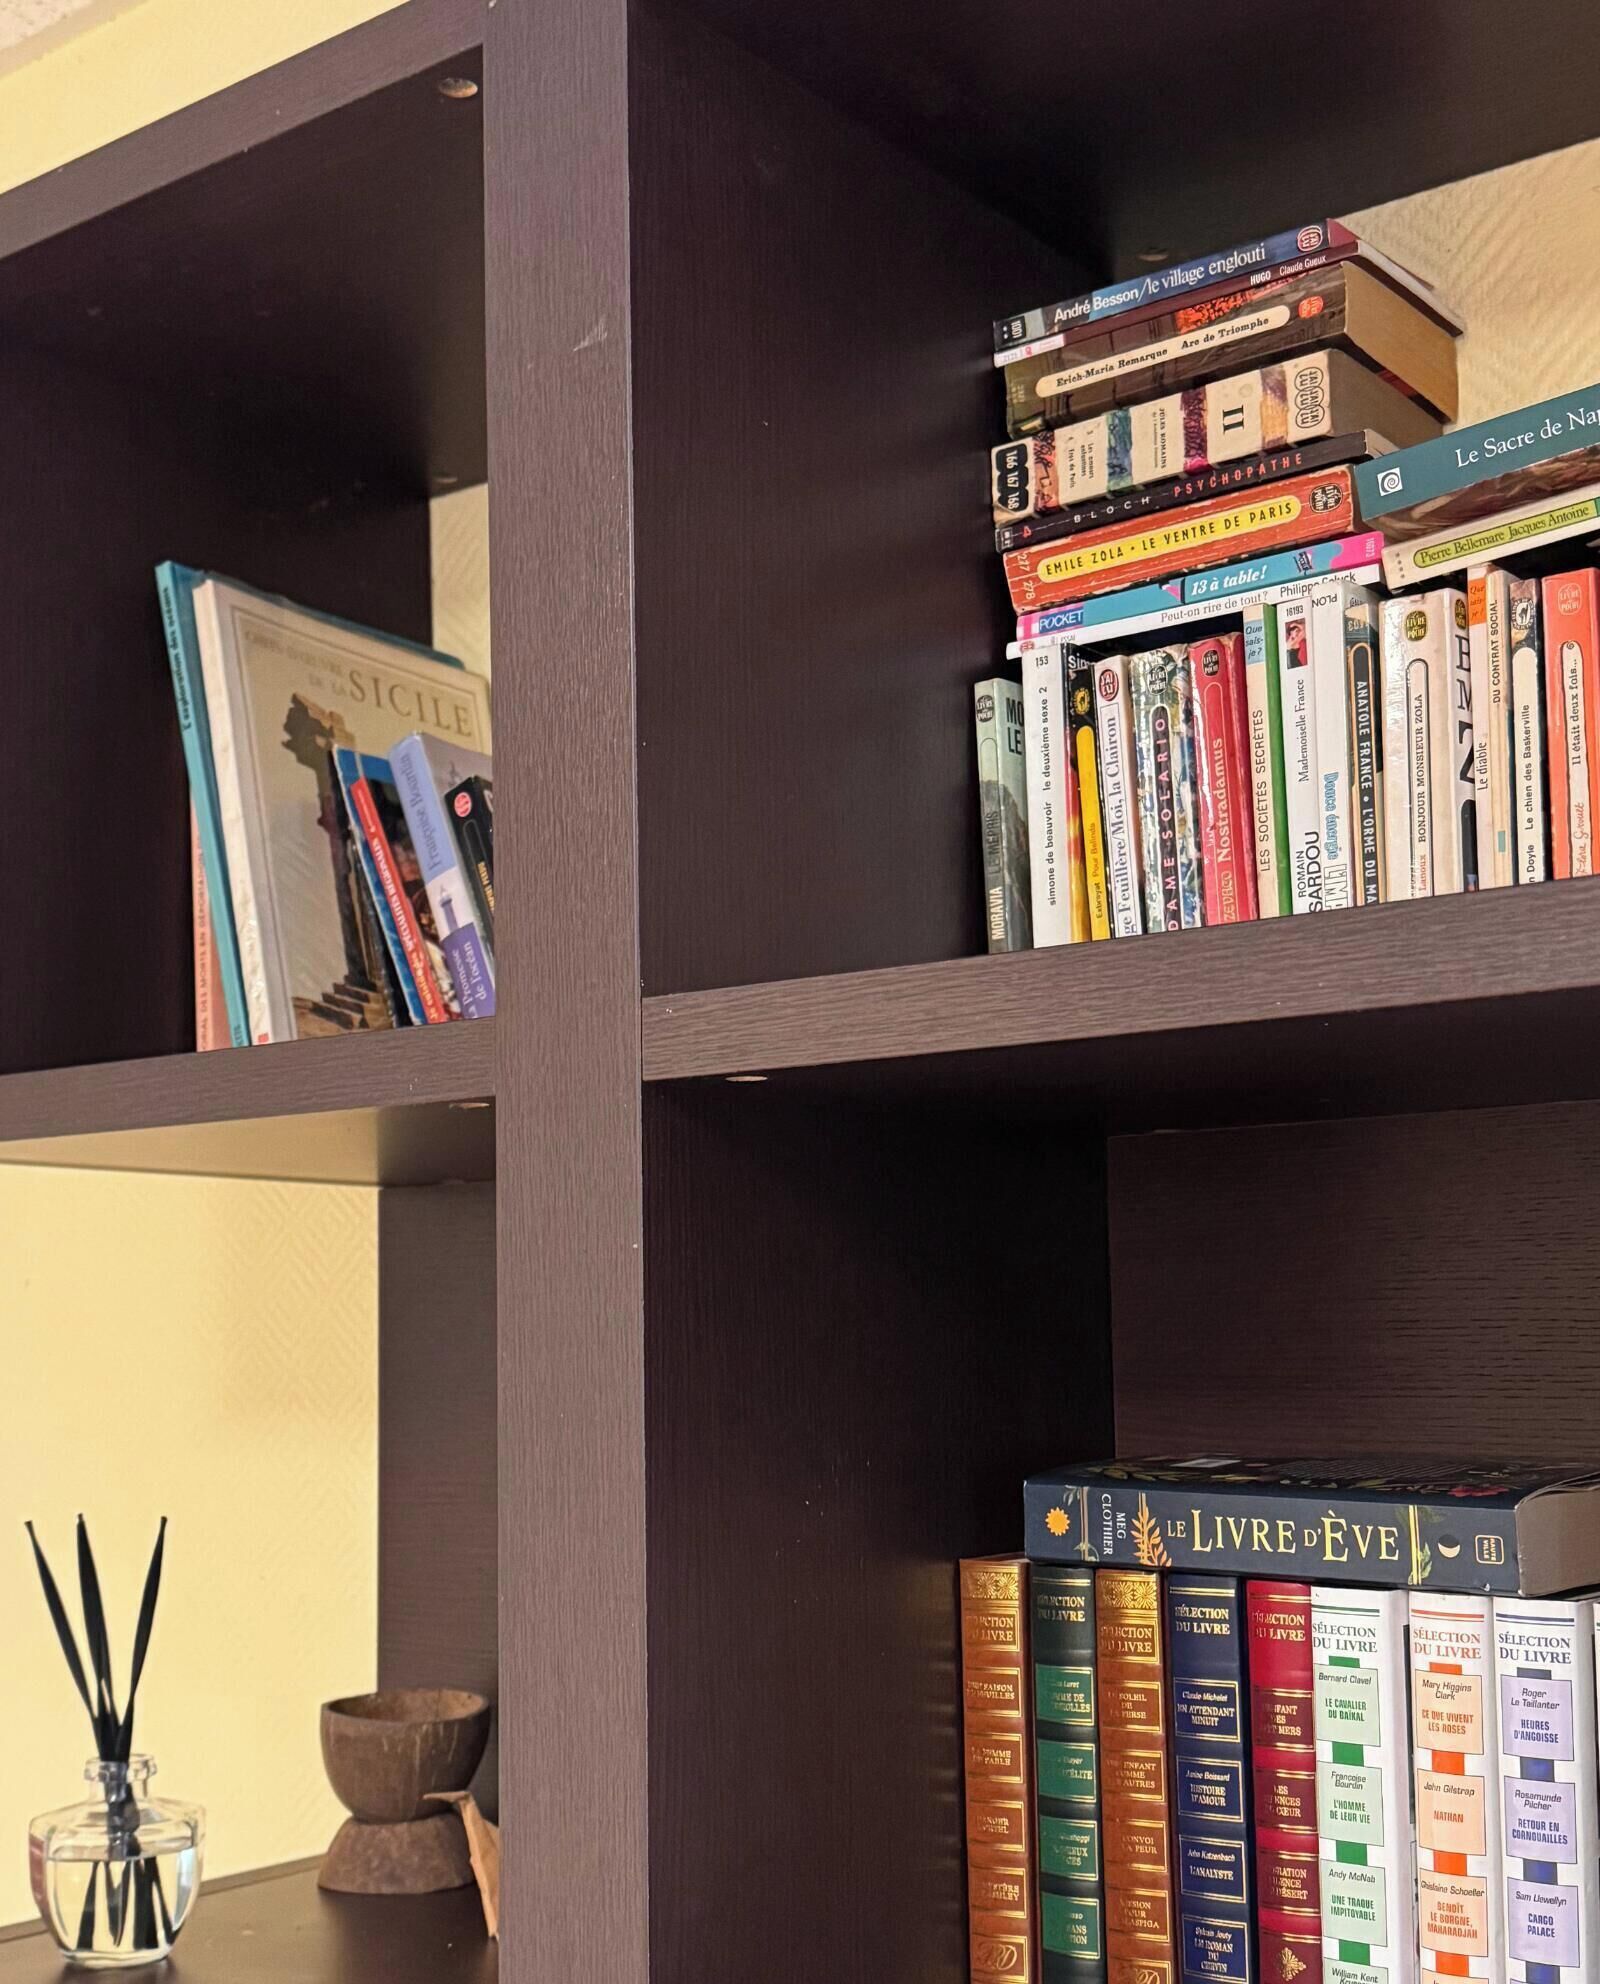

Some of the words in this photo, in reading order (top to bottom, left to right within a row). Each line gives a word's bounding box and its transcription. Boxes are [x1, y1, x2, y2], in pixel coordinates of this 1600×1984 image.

[1250, 270, 1271, 287] HUGO
[1279, 261, 1303, 276] Claude
[1304, 254, 1327, 269] Gueux
[1053, 299, 1091, 324] André
[1160, 264, 1206, 292] village
[1208, 243, 1266, 276] englouti
[1056, 362, 1116, 388] Erich-Maria
[1117, 347, 1168, 370] Remarque
[1180, 337, 1200, 351] Arc
[1202, 333, 1215, 346] de
[1217, 316, 1270, 340] Triomphe
[1455, 448, 1480, 468] Le
[1483, 431, 1535, 458] Sacre
[1540, 419, 1563, 440] de
[1006, 450, 1018, 470] 166
[1007, 472, 1019, 488] 167
[1173, 453, 1302, 498] PSYCHOPATHE
[1046, 557, 1084, 576] EMILE
[1091, 546, 1124, 564] ZOLA
[1142, 537, 1157, 551] LE
[1163, 519, 1215, 545] VENTRE
[1224, 512, 1240, 530] DE
[1250, 502, 1292, 524] PARIS
[1419, 547, 1452, 565] Pierre
[1453, 531, 1505, 554] Bellemare
[1508, 519, 1547, 541] Jacques
[1548, 505, 1590, 527] Antoine
[1039, 609, 1084, 631] POCKET
[1191, 580, 1207, 596] 13
[1209, 576, 1219, 591] à
[1222, 565, 1268, 589] table!
[1311, 594, 1338, 608] PLON
[1160, 606, 1201, 624] Peut-on
[1203, 602, 1222, 616] rire
[1224, 596, 1238, 610] de
[1240, 593, 1262, 607] tout
[1490, 599, 1499, 636] SOCIAL
[1245, 625, 1263, 635] Que
[1035, 655, 1049, 667] 153
[1491, 639, 1500, 686] CONTRAT
[349, 669, 472, 737] SICILE
[1294, 679, 1305, 713] France
[1492, 689, 1501, 704] DU
[1041, 698, 1049, 724] sexe
[1355, 681, 1372, 741] ANATOLE
[1414, 694, 1423, 724] ZOLA
[1570, 694, 1580, 722] deux
[1521, 704, 1532, 759] Baskerville
[1571, 726, 1581, 752] était
[1105, 716, 1120, 778] Clairon
[1252, 708, 1266, 776] SECRÈTES
[1296, 714, 1309, 783] Mademoiselle
[1042, 727, 1052, 778] deuxième
[1415, 727, 1425, 787] MONSIEUR
[1475, 742, 1488, 775] diable
[1358, 741, 1373, 790] FRANCE
[1523, 763, 1532, 781] des
[1042, 781, 1052, 791] le
[1108, 781, 1122, 797] la
[1323, 771, 1339, 812] Douce
[1476, 778, 1488, 791] Le
[1211, 737, 1232, 864] Nostradamus
[1524, 785, 1533, 813] chien
[1044, 801, 1054, 848] beauvoir
[1255, 780, 1269, 851] SOCIÉTÉS
[1416, 791, 1426, 843] BONJOUR
[1524, 817, 1534, 830] Le
[415, 809, 441, 871] Françoise
[1324, 813, 1342, 861] énergie
[1362, 808, 1375, 854] L'ORME
[1045, 850, 1055, 865] de
[1259, 854, 1271, 872] LES
[1526, 844, 1536, 873] Doyle
[1297, 850, 1307, 898] ROMAIN
[1307, 831, 1323, 912] SARDOU
[1364, 860, 1376, 878] DU
[1048, 866, 1057, 906] simone
[1365, 885, 1377, 904] MA
[989, 886, 1005, 940] MORAVIA
[464, 941, 481, 984] l'océan
[452, 949, 476, 1006] Promesse
[475, 984, 487, 1001] de
[1101, 1493, 1114, 1556] CLOTHIER
[1115, 1511, 1127, 1540] MEG
[1167, 1520, 1186, 1538] LE
[1190, 1509, 1297, 1554] LIVRE
[1303, 1509, 1399, 1563] D'ÈVE
[1175, 1604, 1229, 1621] SÉLECTION
[1176, 1621, 1191, 1633] DU
[1192, 1622, 1231, 1635] LIVRE
[1269, 1629, 1306, 1642] LIVRE
[1312, 1622, 1376, 1638] SÉLECTION
[1412, 1627, 1481, 1644] SÉLECTION
[1312, 1636, 1332, 1650] DU
[1335, 1639, 1378, 1653] LIVRE
[1498, 1631, 1571, 1649] SÉLECTION
[1413, 1642, 1432, 1655] DU
[1436, 1644, 1482, 1660] LIVRE
[1500, 1647, 1519, 1660] DU
[1524, 1649, 1572, 1665] LIVRE
[1318, 1671, 1348, 1683] Bernard
[1349, 1674, 1372, 1685] Clavel
[1422, 1679, 1441, 1692] Mary
[1442, 1681, 1472, 1696] Higgins
[1435, 1690, 1456, 1701] Clark
[1521, 1687, 1547, 1699] Roger
[1188, 1704, 1235, 1718] ATTENDANT
[1325, 1698, 1333, 1708] LE
[1334, 1699, 1367, 1711] CAVALIER
[1511, 1697, 1520, 1706] Le
[1521, 1698, 1560, 1710] Taillanter
[1191, 1715, 1220, 1726] MINUIT
[1328, 1708, 1338, 1719] DU
[1421, 1709, 1430, 1720] CE
[1431, 1710, 1445, 1721] QUE
[1446, 1712, 1474, 1724] VIVENT
[1278, 1726, 1302, 1737] MERS
[1428, 1722, 1441, 1733] LES
[1442, 1723, 1466, 1735] ROSES
[1520, 1718, 1550, 1731] HEURES
[1513, 1729, 1559, 1744] D'ANGOISSE
[1190, 1783, 1226, 1796] HISTOIRE
[1334, 1780, 1363, 1791] Bourdin
[1423, 1782, 1441, 1793] John
[1443, 1784, 1475, 1797] Gilstrap
[1514, 1789, 1562, 1803] Rosamunde
[1523, 1799, 1552, 1811] Pilcher
[1333, 1799, 1366, 1812] L'HOMME
[1329, 1809, 1339, 1820] DE
[1340, 1810, 1357, 1822] LEUR
[1359, 1812, 1371, 1824] VIE
[1433, 1810, 1464, 1823] NATHAN
[1518, 1818, 1547, 1832] RETOUR
[1548, 1821, 1560, 1832] EN
[1512, 1829, 1568, 1845] CORNOUAILLES
[1189, 1865, 1234, 1881] L'ANALYSTE
[1328, 1869, 1347, 1882] Andy
[1348, 1872, 1376, 1884] McNab
[1331, 1894, 1345, 1906] UNE
[1346, 1896, 1374, 1910] TRAQUE
[1515, 1891, 1531, 1902] Sam
[1330, 1906, 1376, 1922] IMPITOYABLE
[1430, 1911, 1438, 1922] LE
[1528, 1913, 1554, 1926] CARGO
[1427, 1922, 1478, 1939] MAHARADJAH
[1527, 1925, 1556, 1938] PALACE
[1331, 1967, 1358, 1980] William
[1360, 1972, 1379, 1983] Kent
